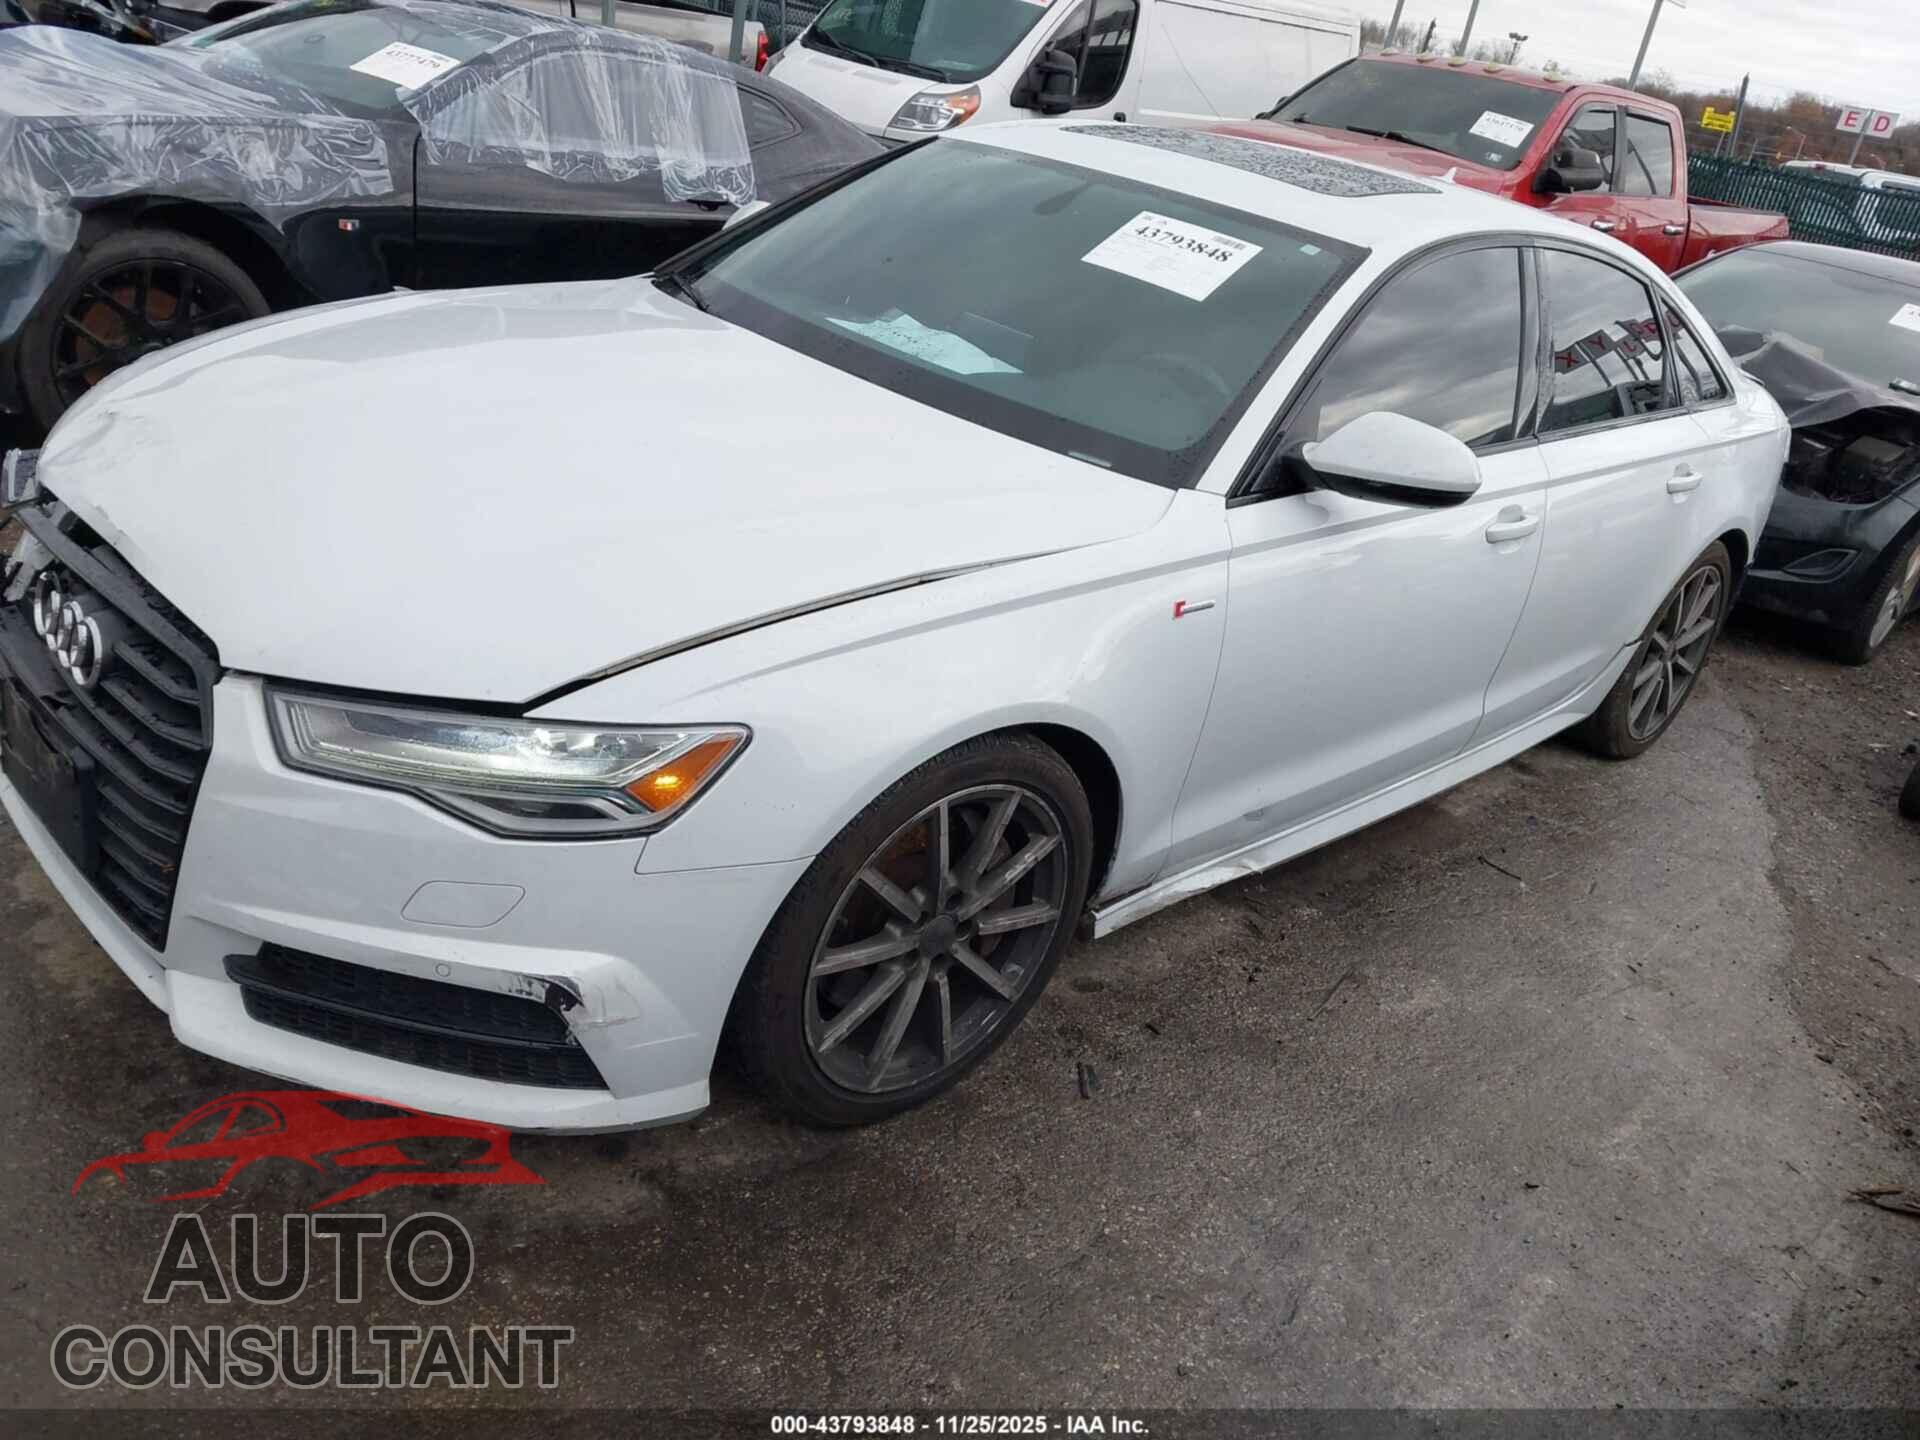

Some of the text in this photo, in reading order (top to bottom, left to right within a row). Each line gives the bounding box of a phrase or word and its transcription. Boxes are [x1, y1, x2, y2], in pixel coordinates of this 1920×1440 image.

[1844, 110, 1891, 132] E D
[1135, 226, 1233, 263] 43793848
